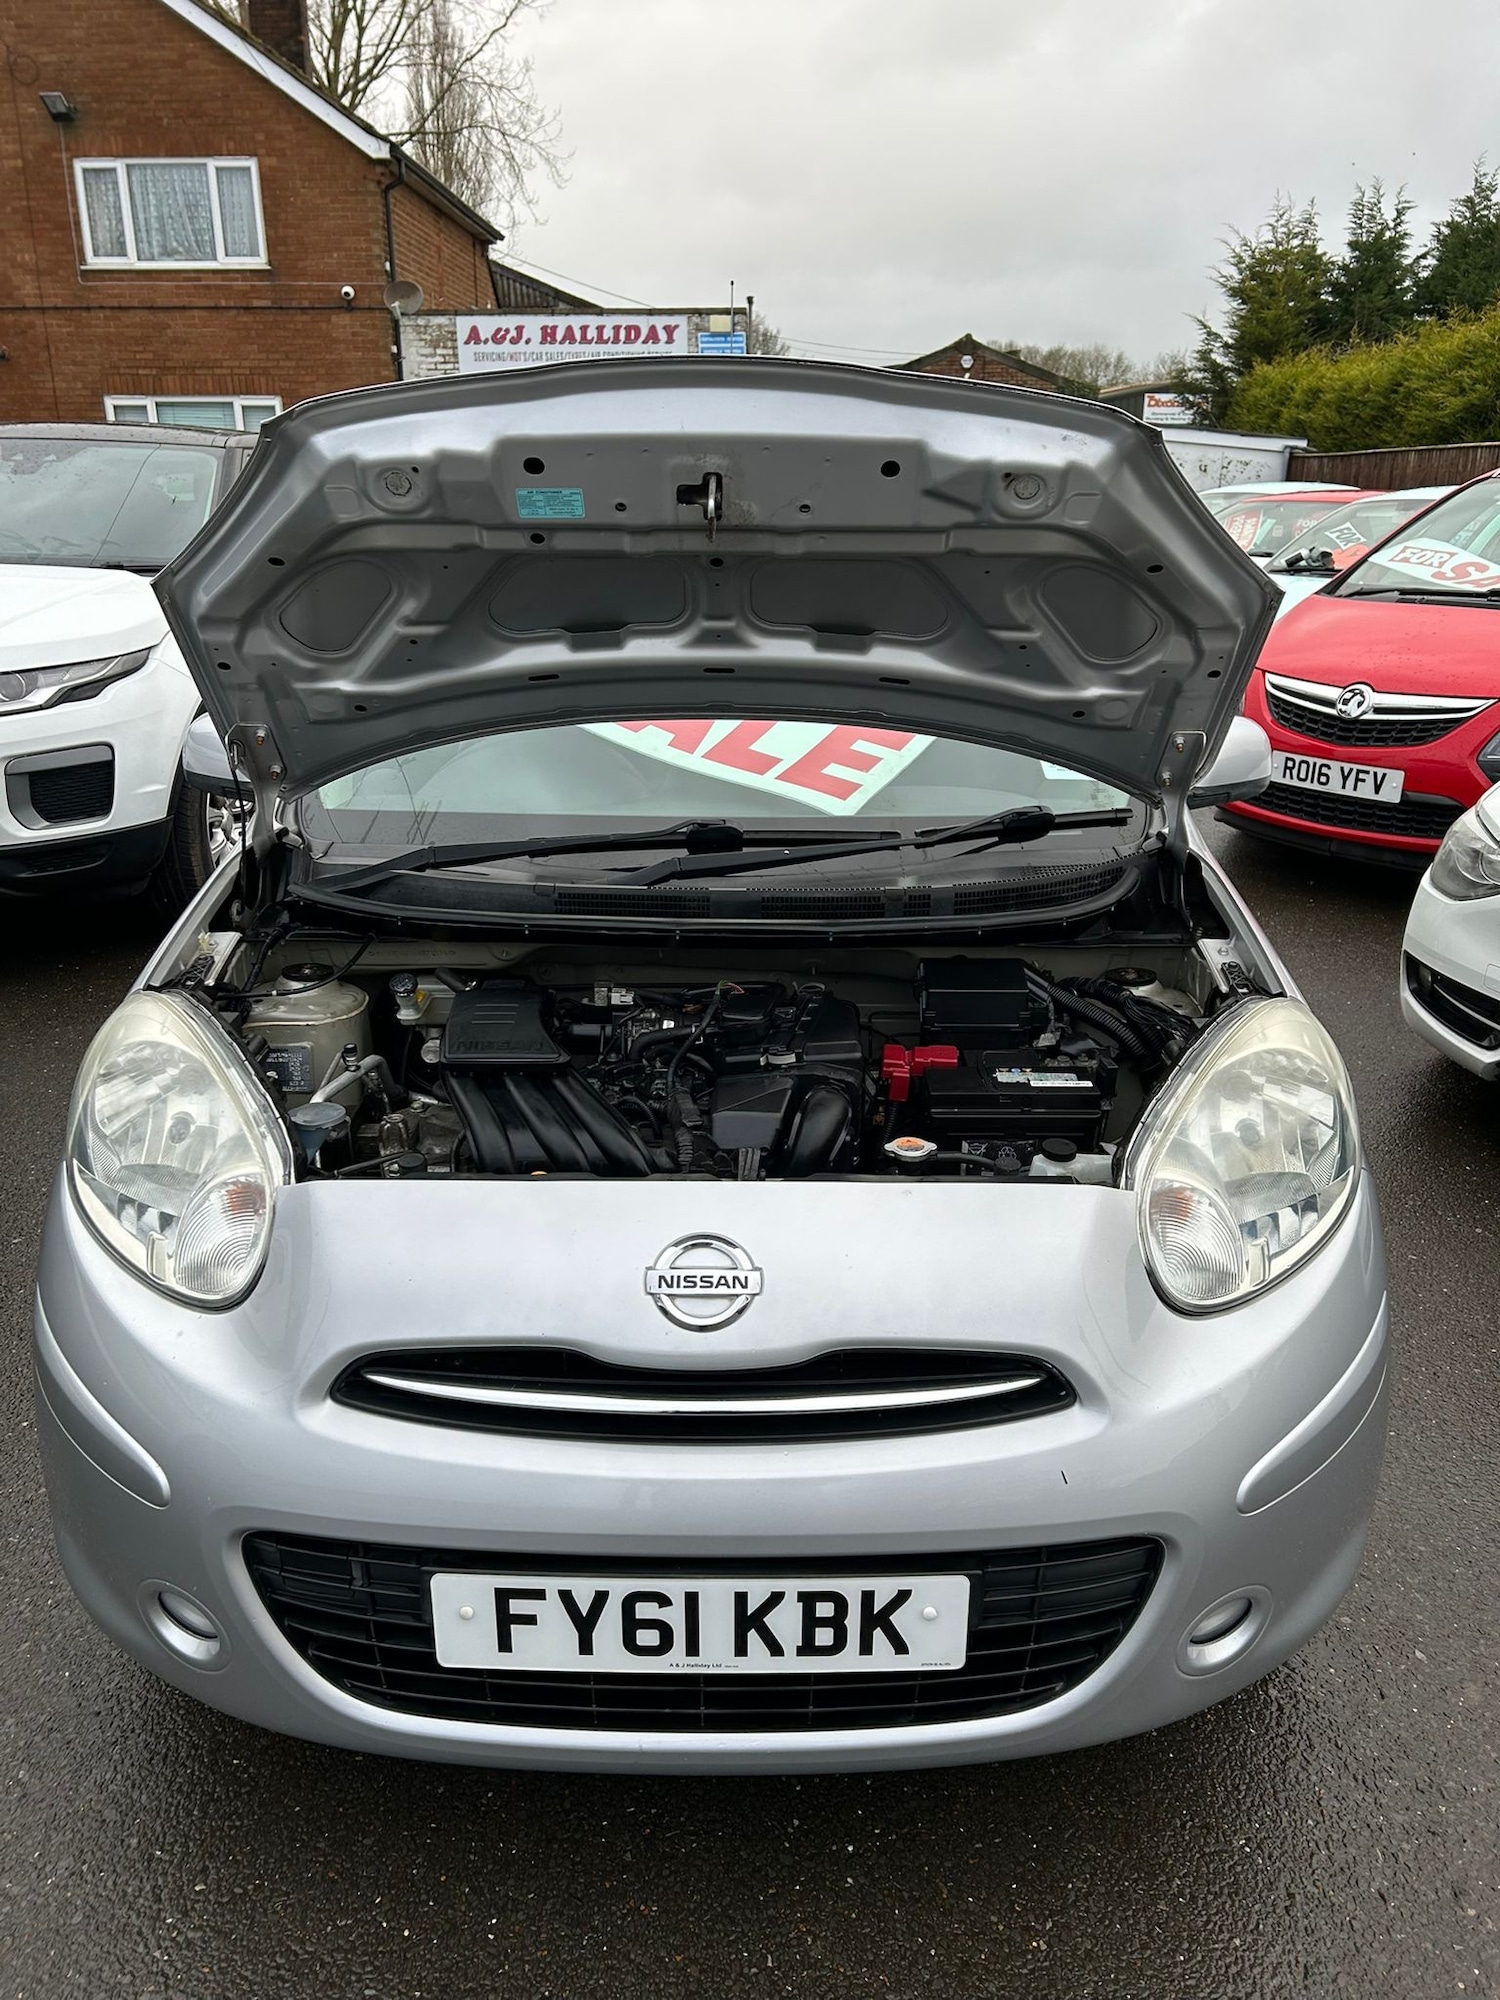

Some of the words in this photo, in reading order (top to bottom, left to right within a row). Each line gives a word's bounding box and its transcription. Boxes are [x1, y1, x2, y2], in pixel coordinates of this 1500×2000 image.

[539, 324, 680, 345] HALLIDAY
[1329, 525, 1362, 547] FOR
[1391, 547, 1452, 567] FOR
[1282, 756, 1332, 786] RO16
[1340, 766, 1388, 795] YFV
[658, 1275, 748, 1289] NISSAN
[494, 1587, 700, 1657] FY61
[734, 1589, 913, 1657] KBK
